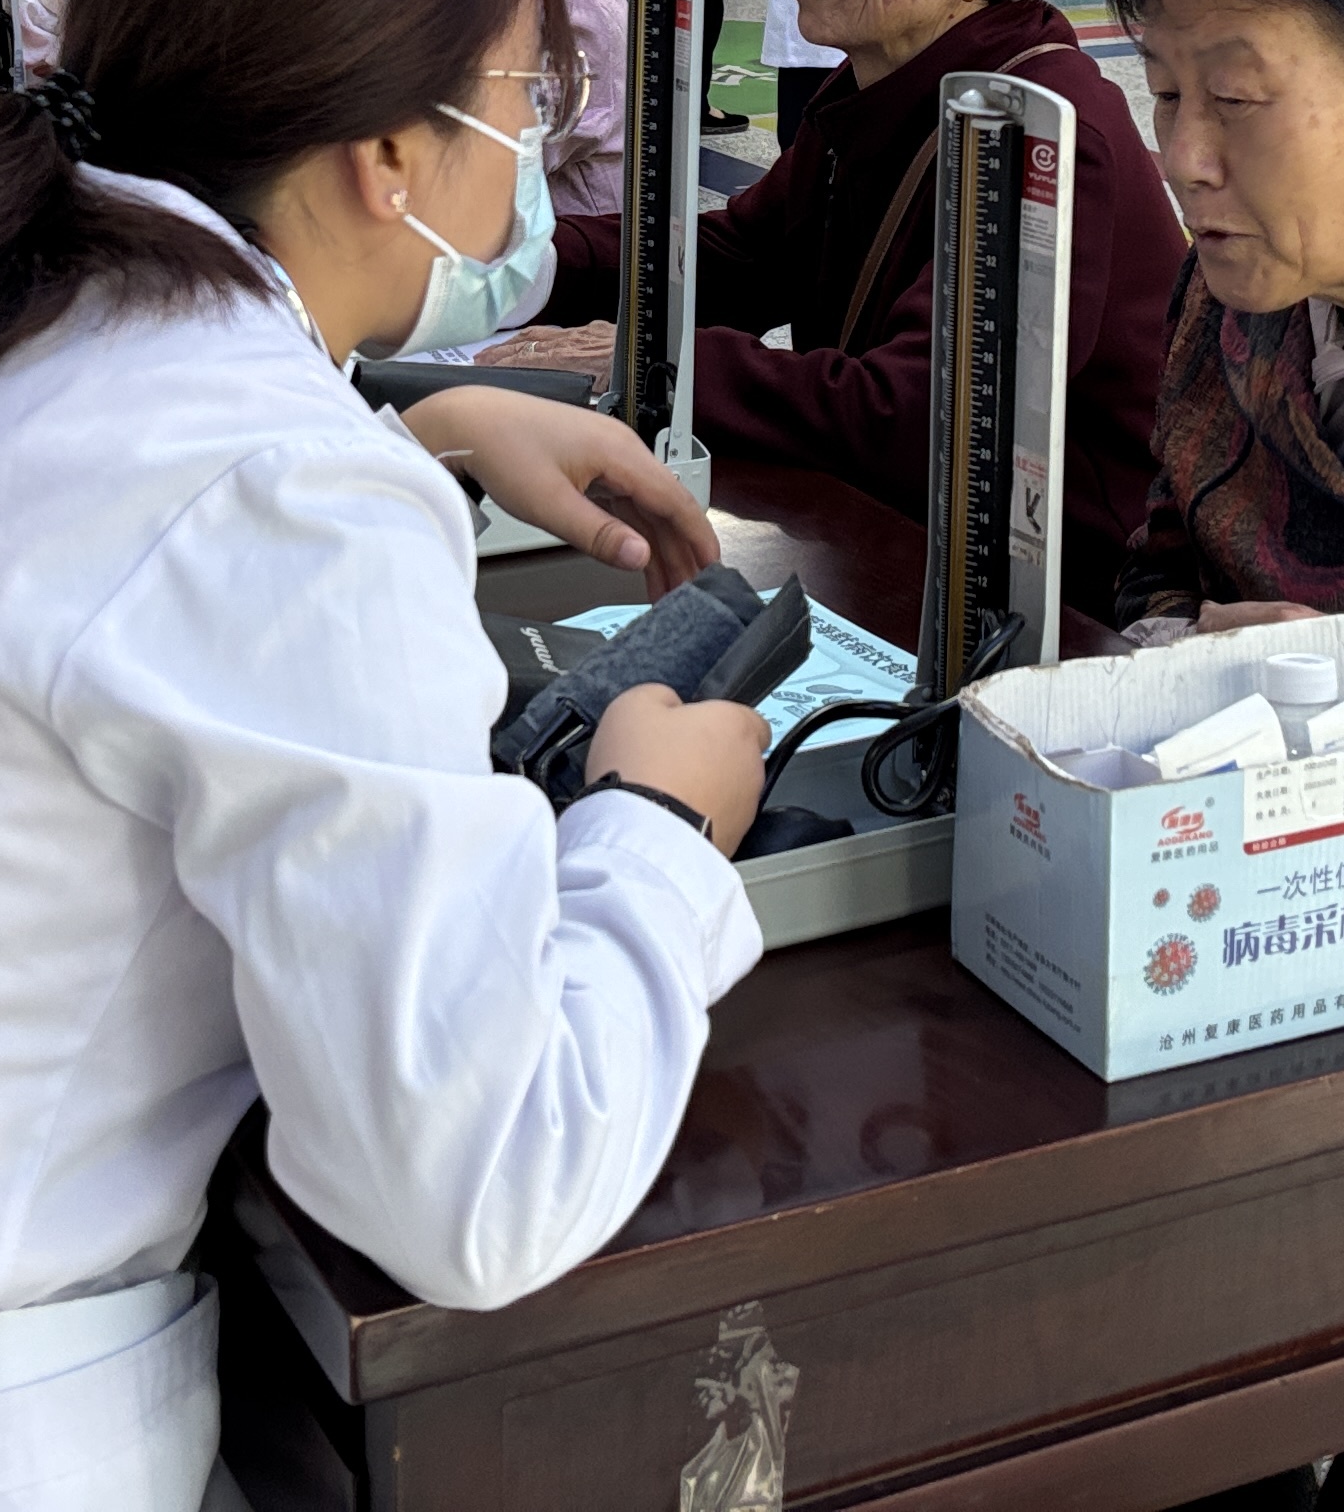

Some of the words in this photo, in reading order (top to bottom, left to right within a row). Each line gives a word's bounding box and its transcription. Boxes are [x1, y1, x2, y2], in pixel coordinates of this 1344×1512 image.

[986, 223, 998, 234] 34
[985, 255, 997, 267] 32
[984, 288, 996, 300] 30
[983, 320, 995, 332] 28
[982, 352, 994, 364] 26
[982, 385, 993, 396] 24
[981, 417, 992, 428] 22
[980, 448, 991, 460] 20
[979, 513, 989, 524] 16
[978, 545, 988, 556] 14
[977, 576, 988, 587] 12
